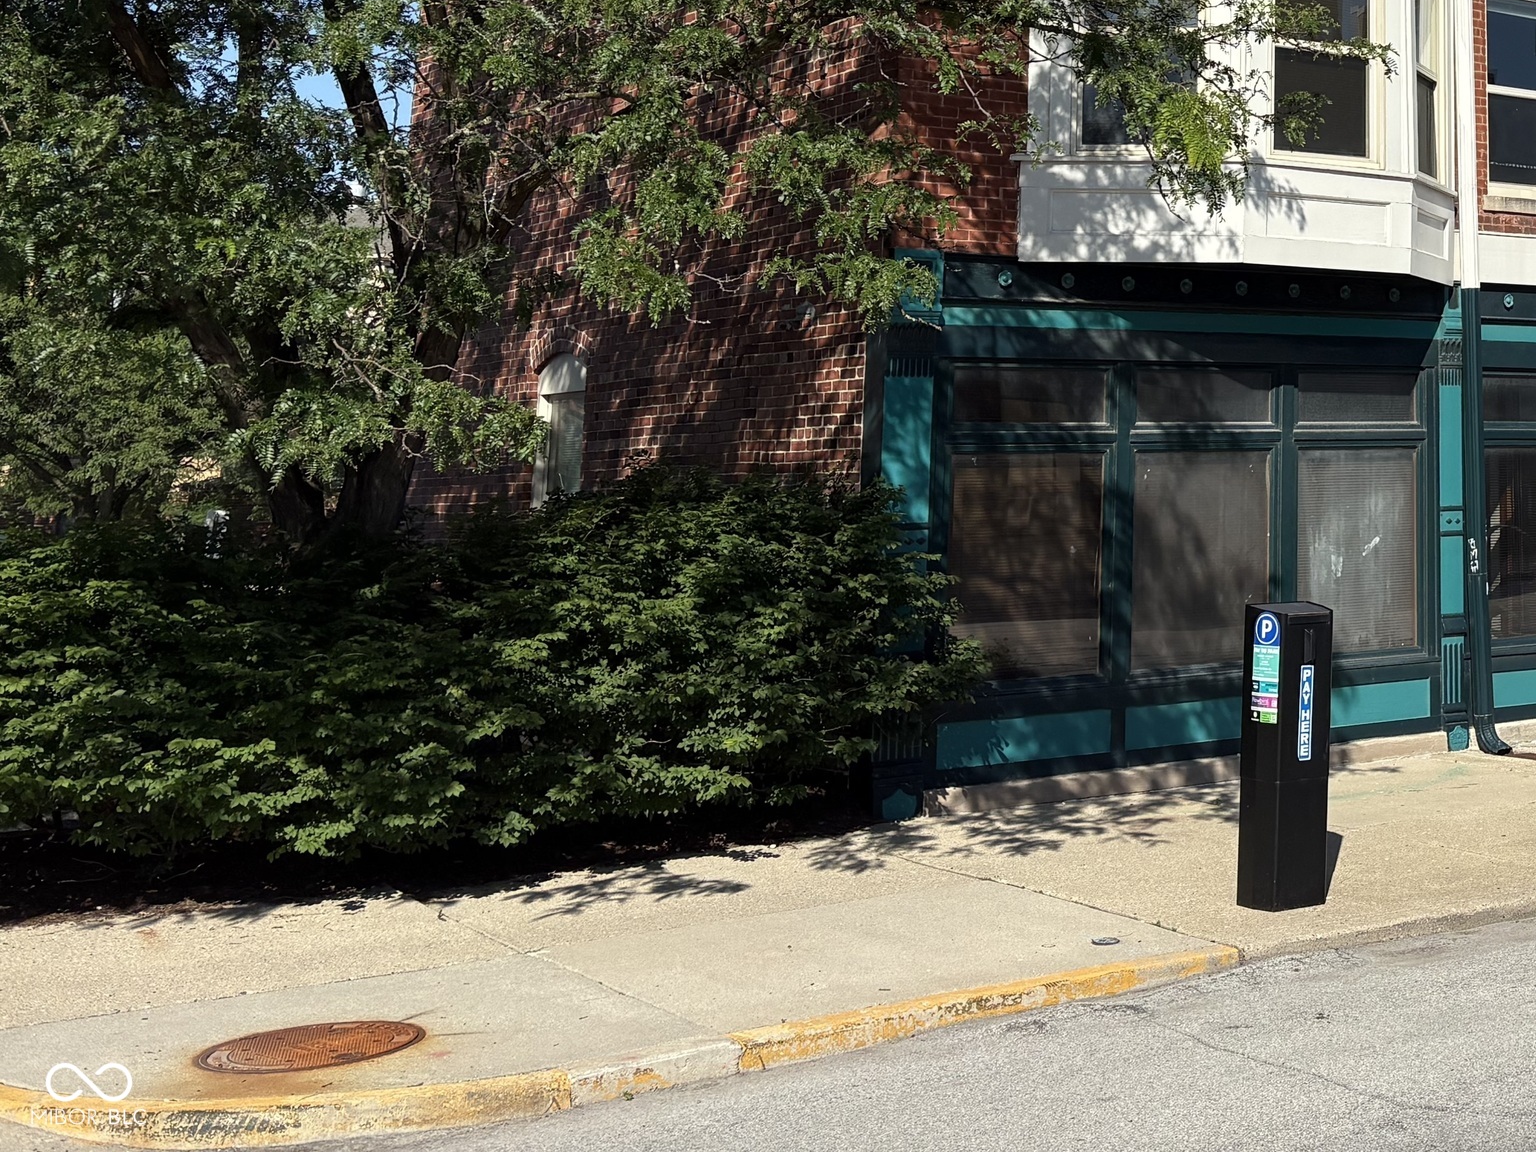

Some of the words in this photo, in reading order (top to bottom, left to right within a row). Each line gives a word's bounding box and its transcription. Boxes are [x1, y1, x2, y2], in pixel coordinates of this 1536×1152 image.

[1261, 619, 1273, 639] P
[1302, 669, 1311, 705] PAY
[1300, 709, 1310, 757] HERE
